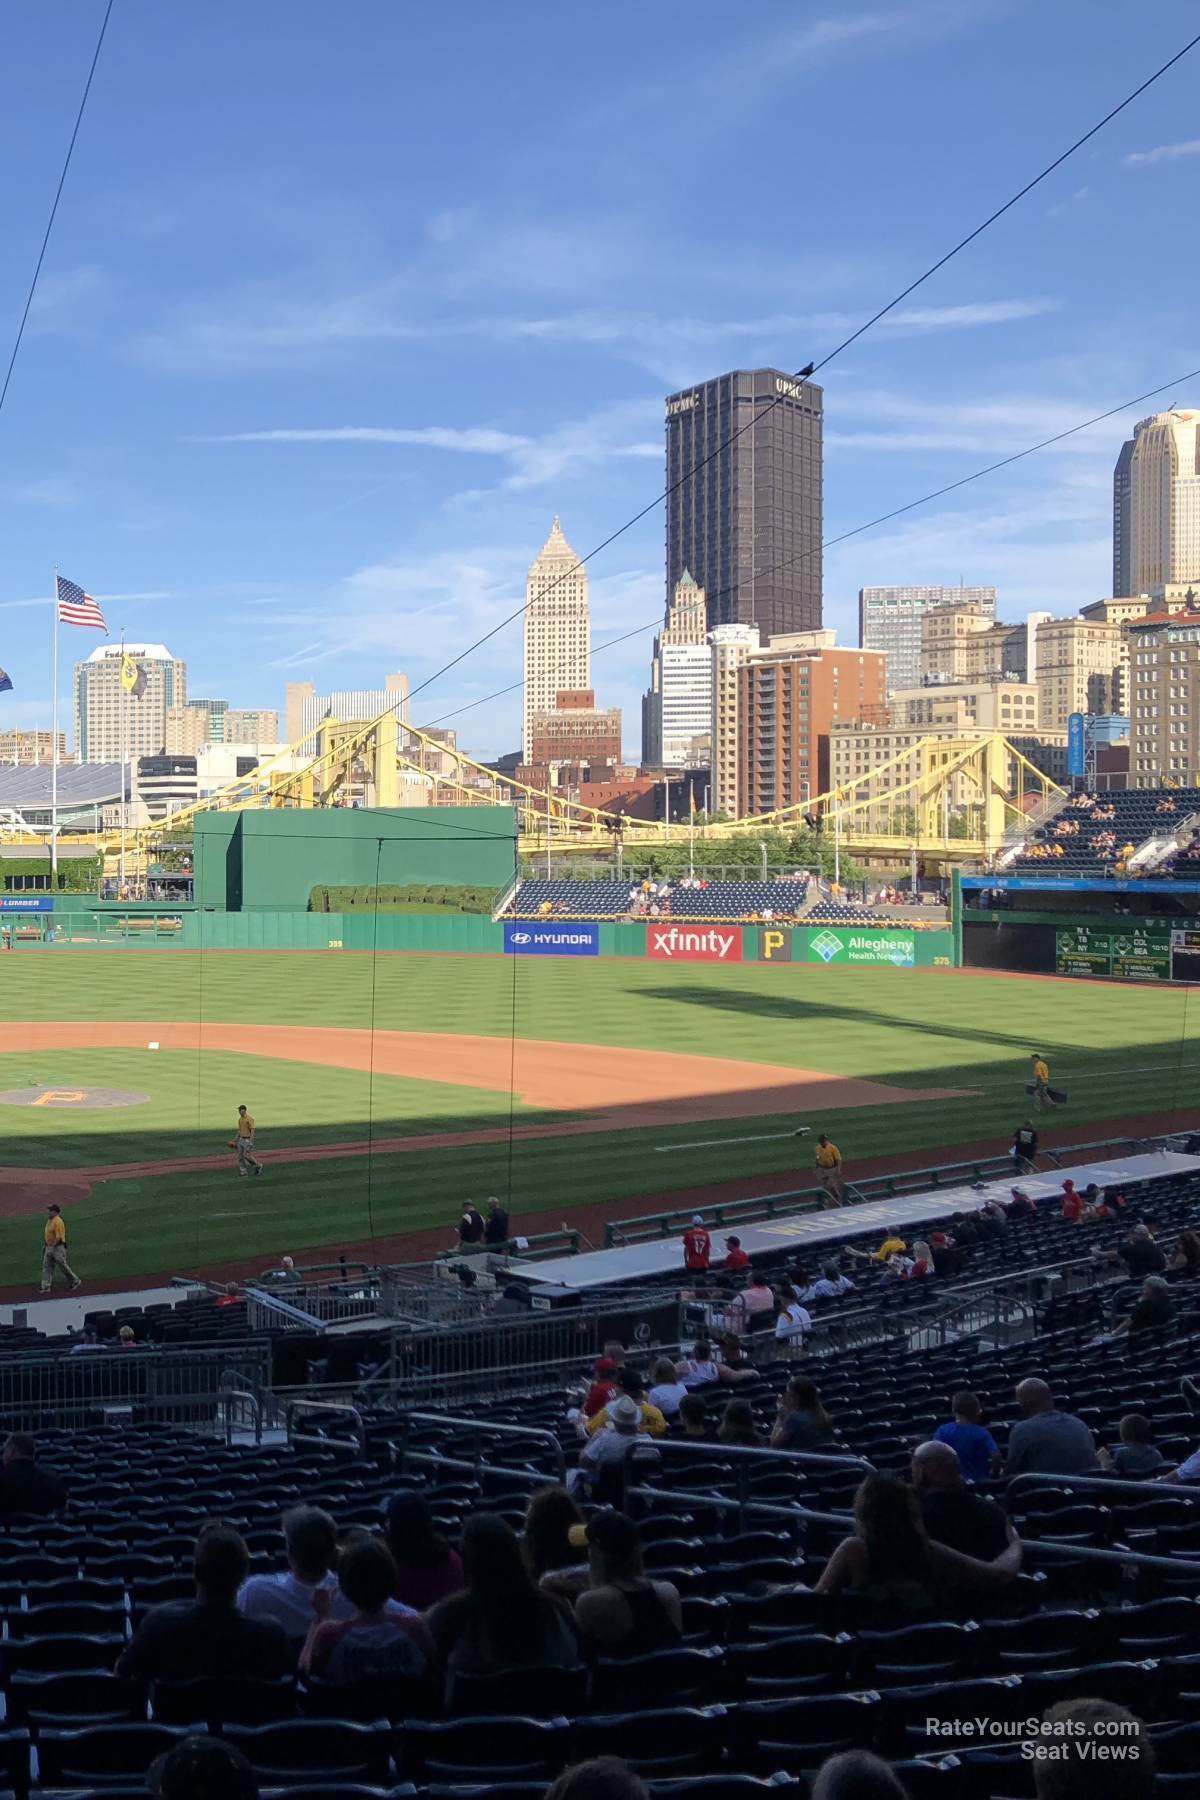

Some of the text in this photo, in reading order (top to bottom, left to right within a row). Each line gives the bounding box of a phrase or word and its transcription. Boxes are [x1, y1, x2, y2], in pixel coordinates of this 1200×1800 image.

[775, 378, 802, 400] UPMC
[534, 933, 592, 945] HYUNDAI
[653, 927, 736, 957] xfinity
[763, 930, 785, 959] P
[848, 937, 914, 953] Allegheny
[848, 952, 913, 962] Health Network
